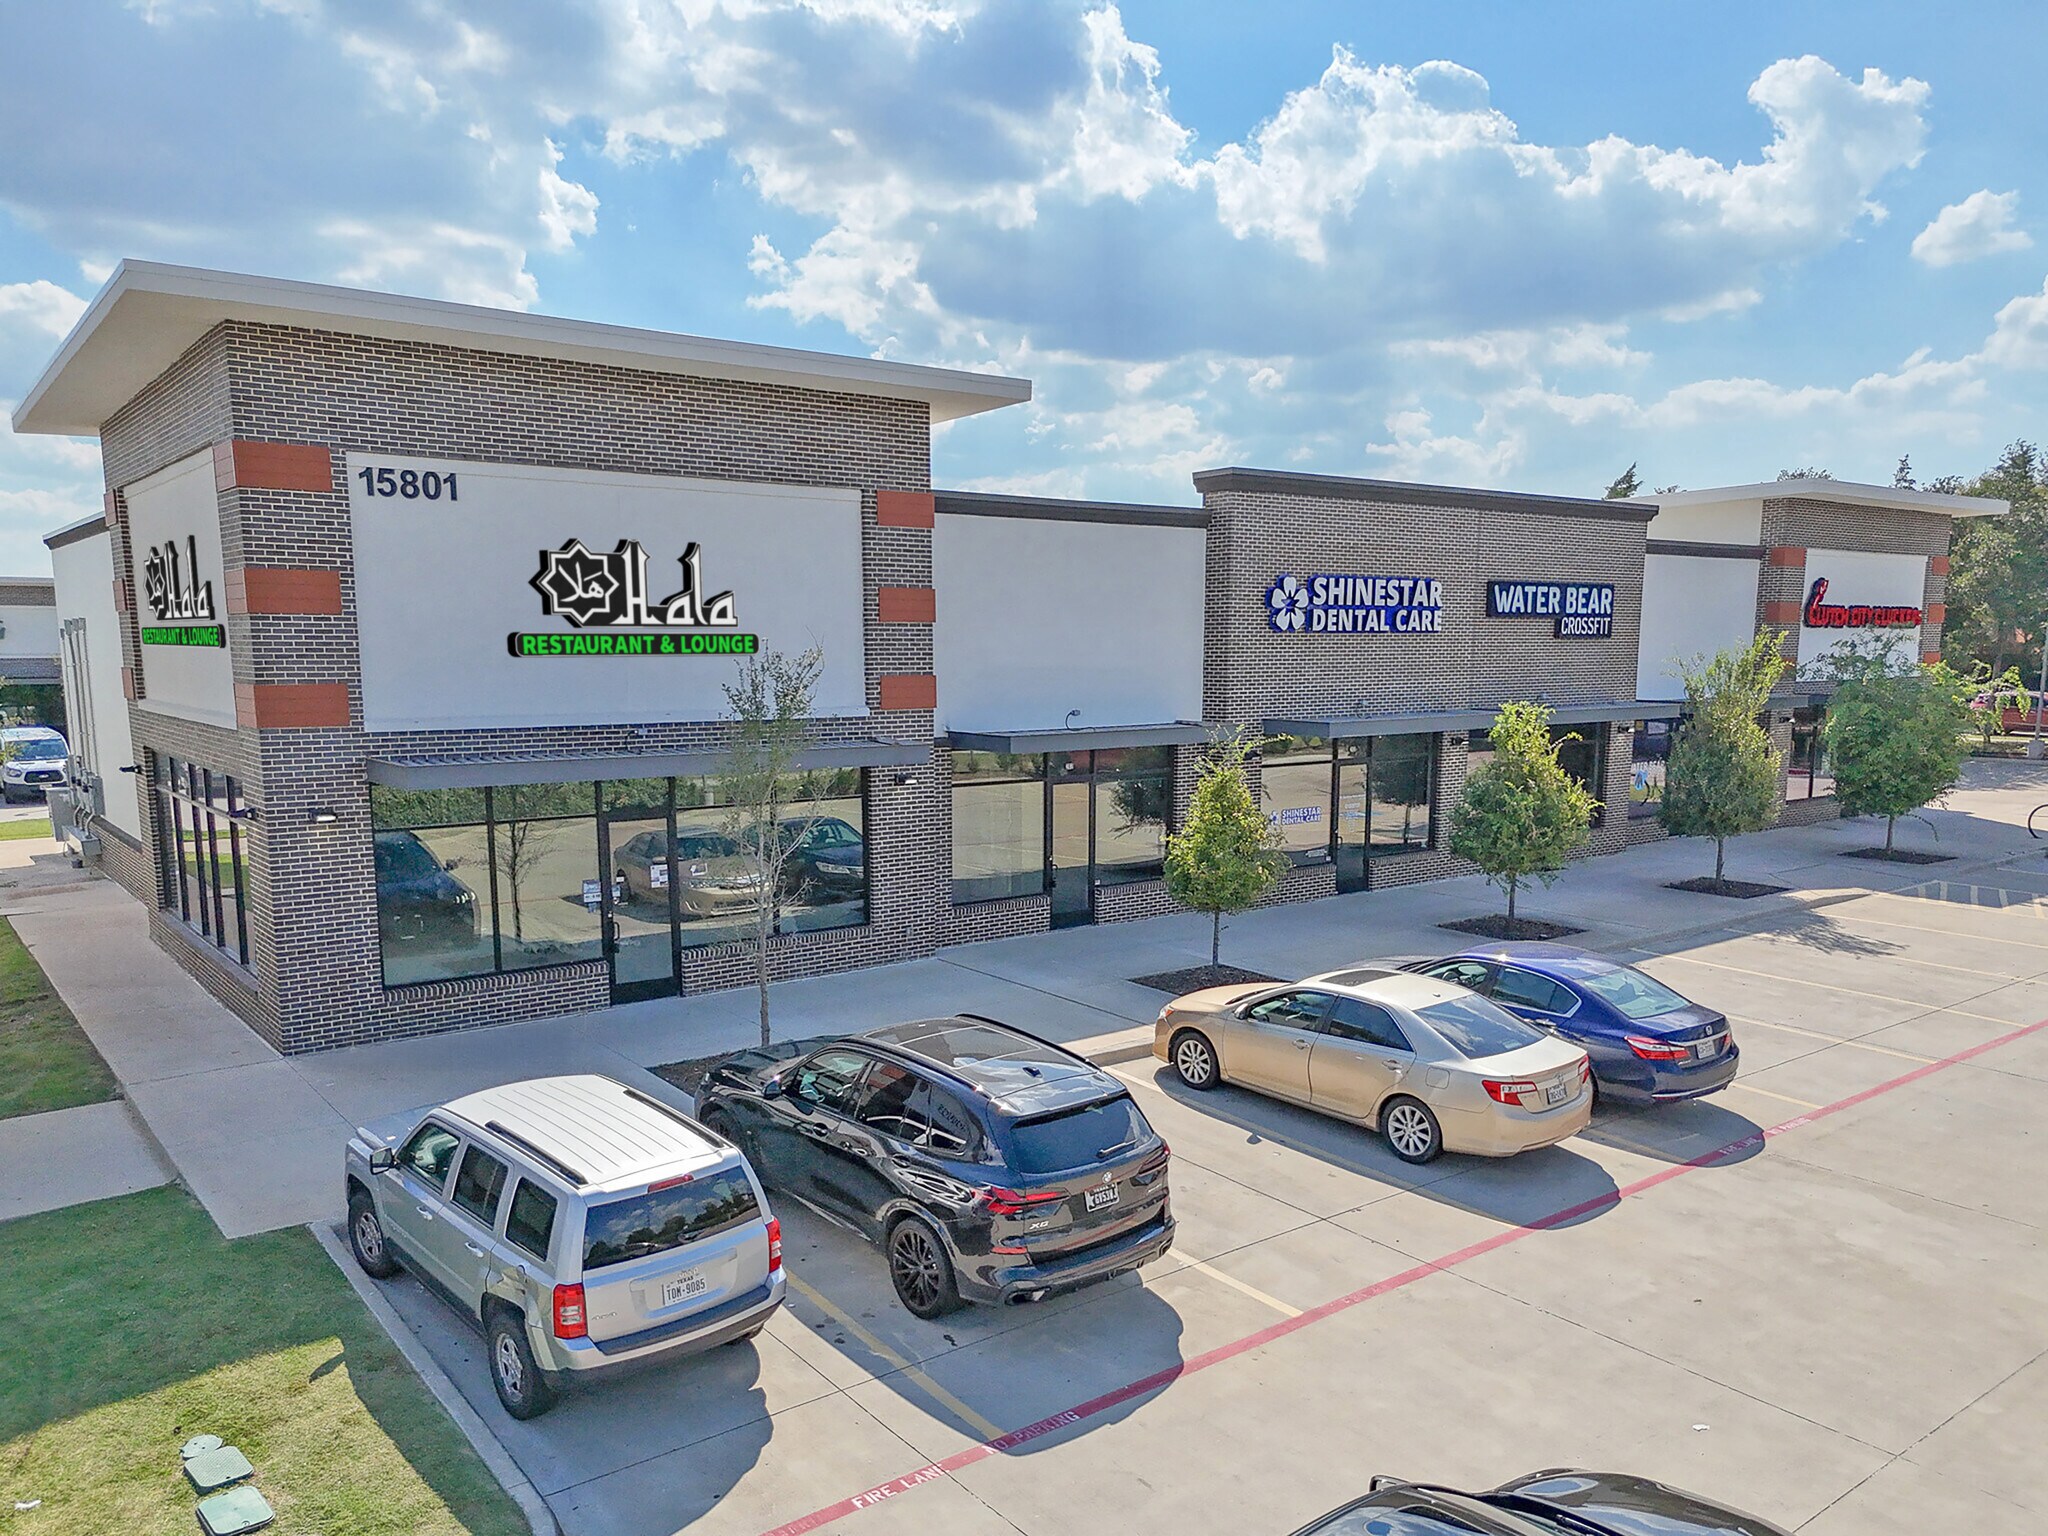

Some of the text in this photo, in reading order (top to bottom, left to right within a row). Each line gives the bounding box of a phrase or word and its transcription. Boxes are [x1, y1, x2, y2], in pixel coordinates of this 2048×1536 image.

[358, 467, 458, 501] 15801
[164, 538, 210, 619] Hala
[609, 541, 738, 625] Hala
[1312, 576, 1443, 607] SHINESTAR
[1494, 584, 1613, 615] WATER BEAR
[1312, 608, 1443, 632] DENTAL CARE
[1561, 617, 1611, 635] CROSSFIT
[142, 628, 180, 645] RESTAURANT
[188, 627, 219, 646] LOUNGE
[522, 635, 754, 655] RESTAURANT & LOUNGE
[1282, 807, 1322, 818] SHINESTAR
[676, 1275, 694, 1284] TEXAS
[981, 1411, 1081, 1455] NO PARKING
[850, 1463, 950, 1509] FIRE LANE
